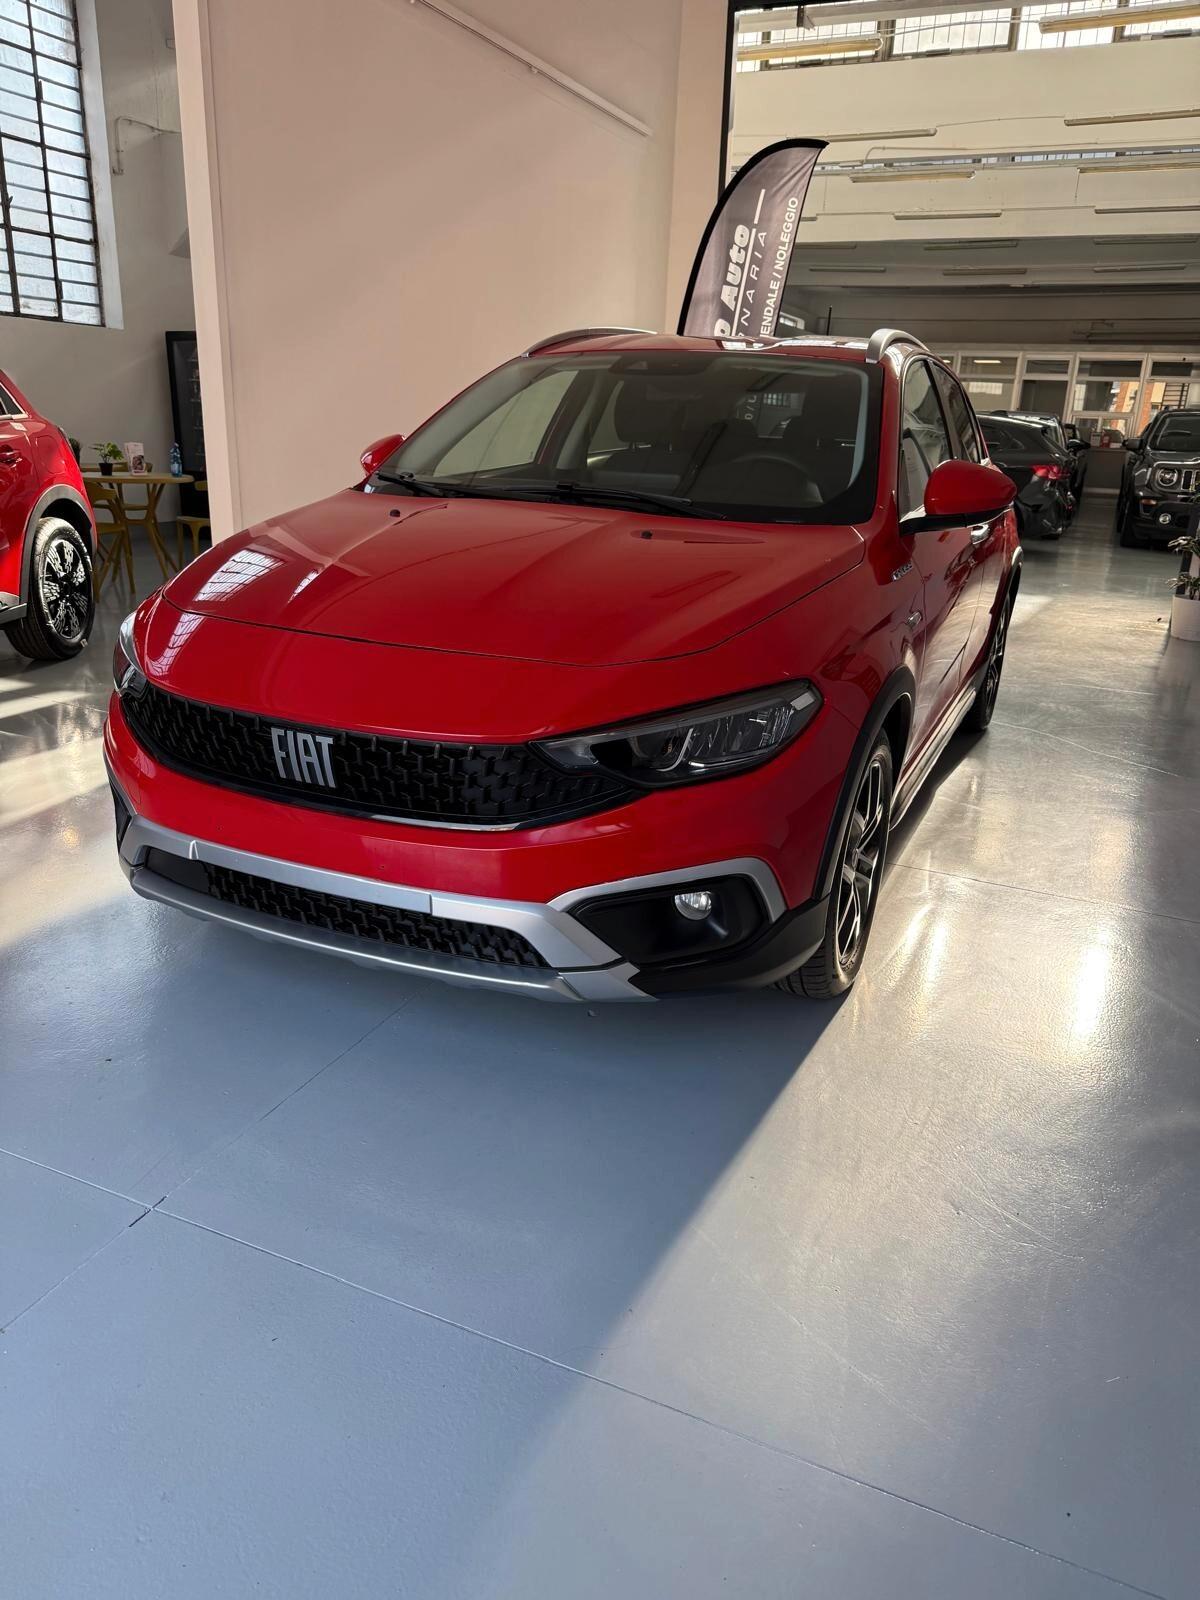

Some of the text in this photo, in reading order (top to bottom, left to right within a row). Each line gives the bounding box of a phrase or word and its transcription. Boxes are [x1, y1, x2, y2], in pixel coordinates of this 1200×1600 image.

[721, 224, 750, 312] Auto
[774, 197, 799, 271] NOLEGGIO
[271, 727, 336, 788] FIAT
